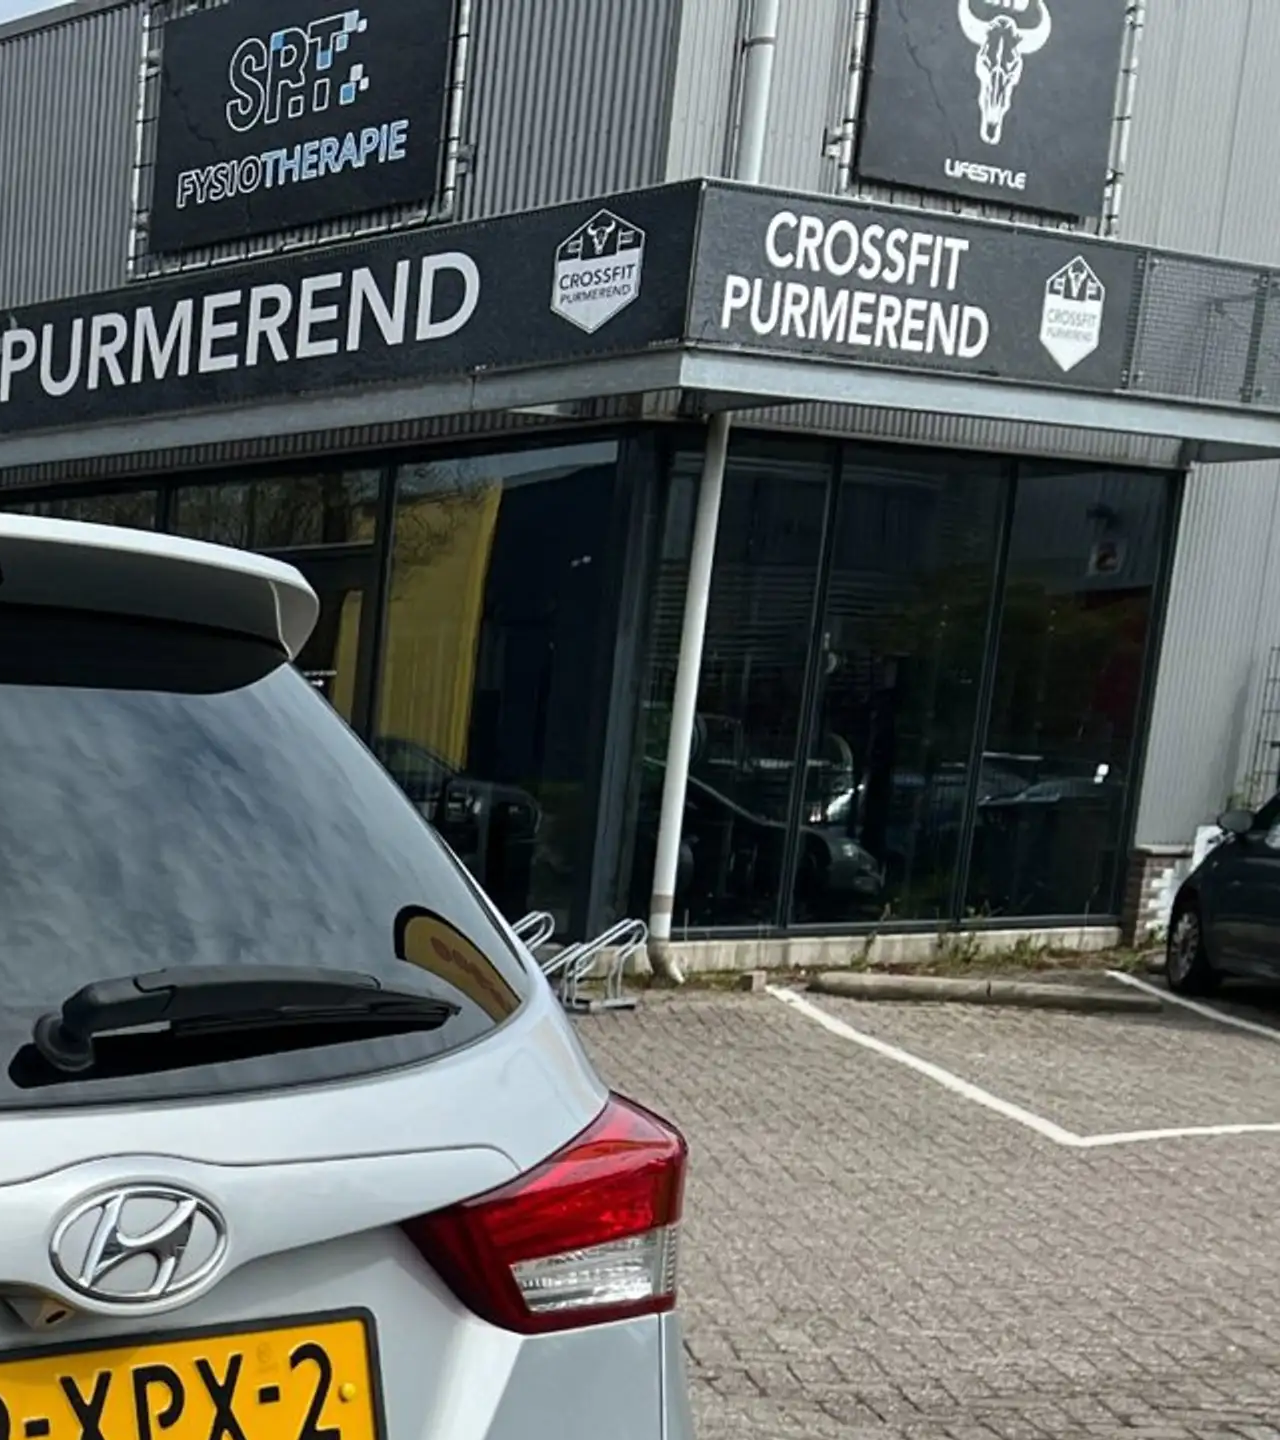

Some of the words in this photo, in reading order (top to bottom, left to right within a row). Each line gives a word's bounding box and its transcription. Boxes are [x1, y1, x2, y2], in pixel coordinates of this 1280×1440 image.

[176, 119, 409, 208] FYSIOTHERAPIE
[945, 158, 1027, 190] LIFESTYLE
[560, 264, 635, 290] CROSSFIT
[765, 210, 969, 291] CROSSFIT
[721, 276, 989, 359] PURMEREND
